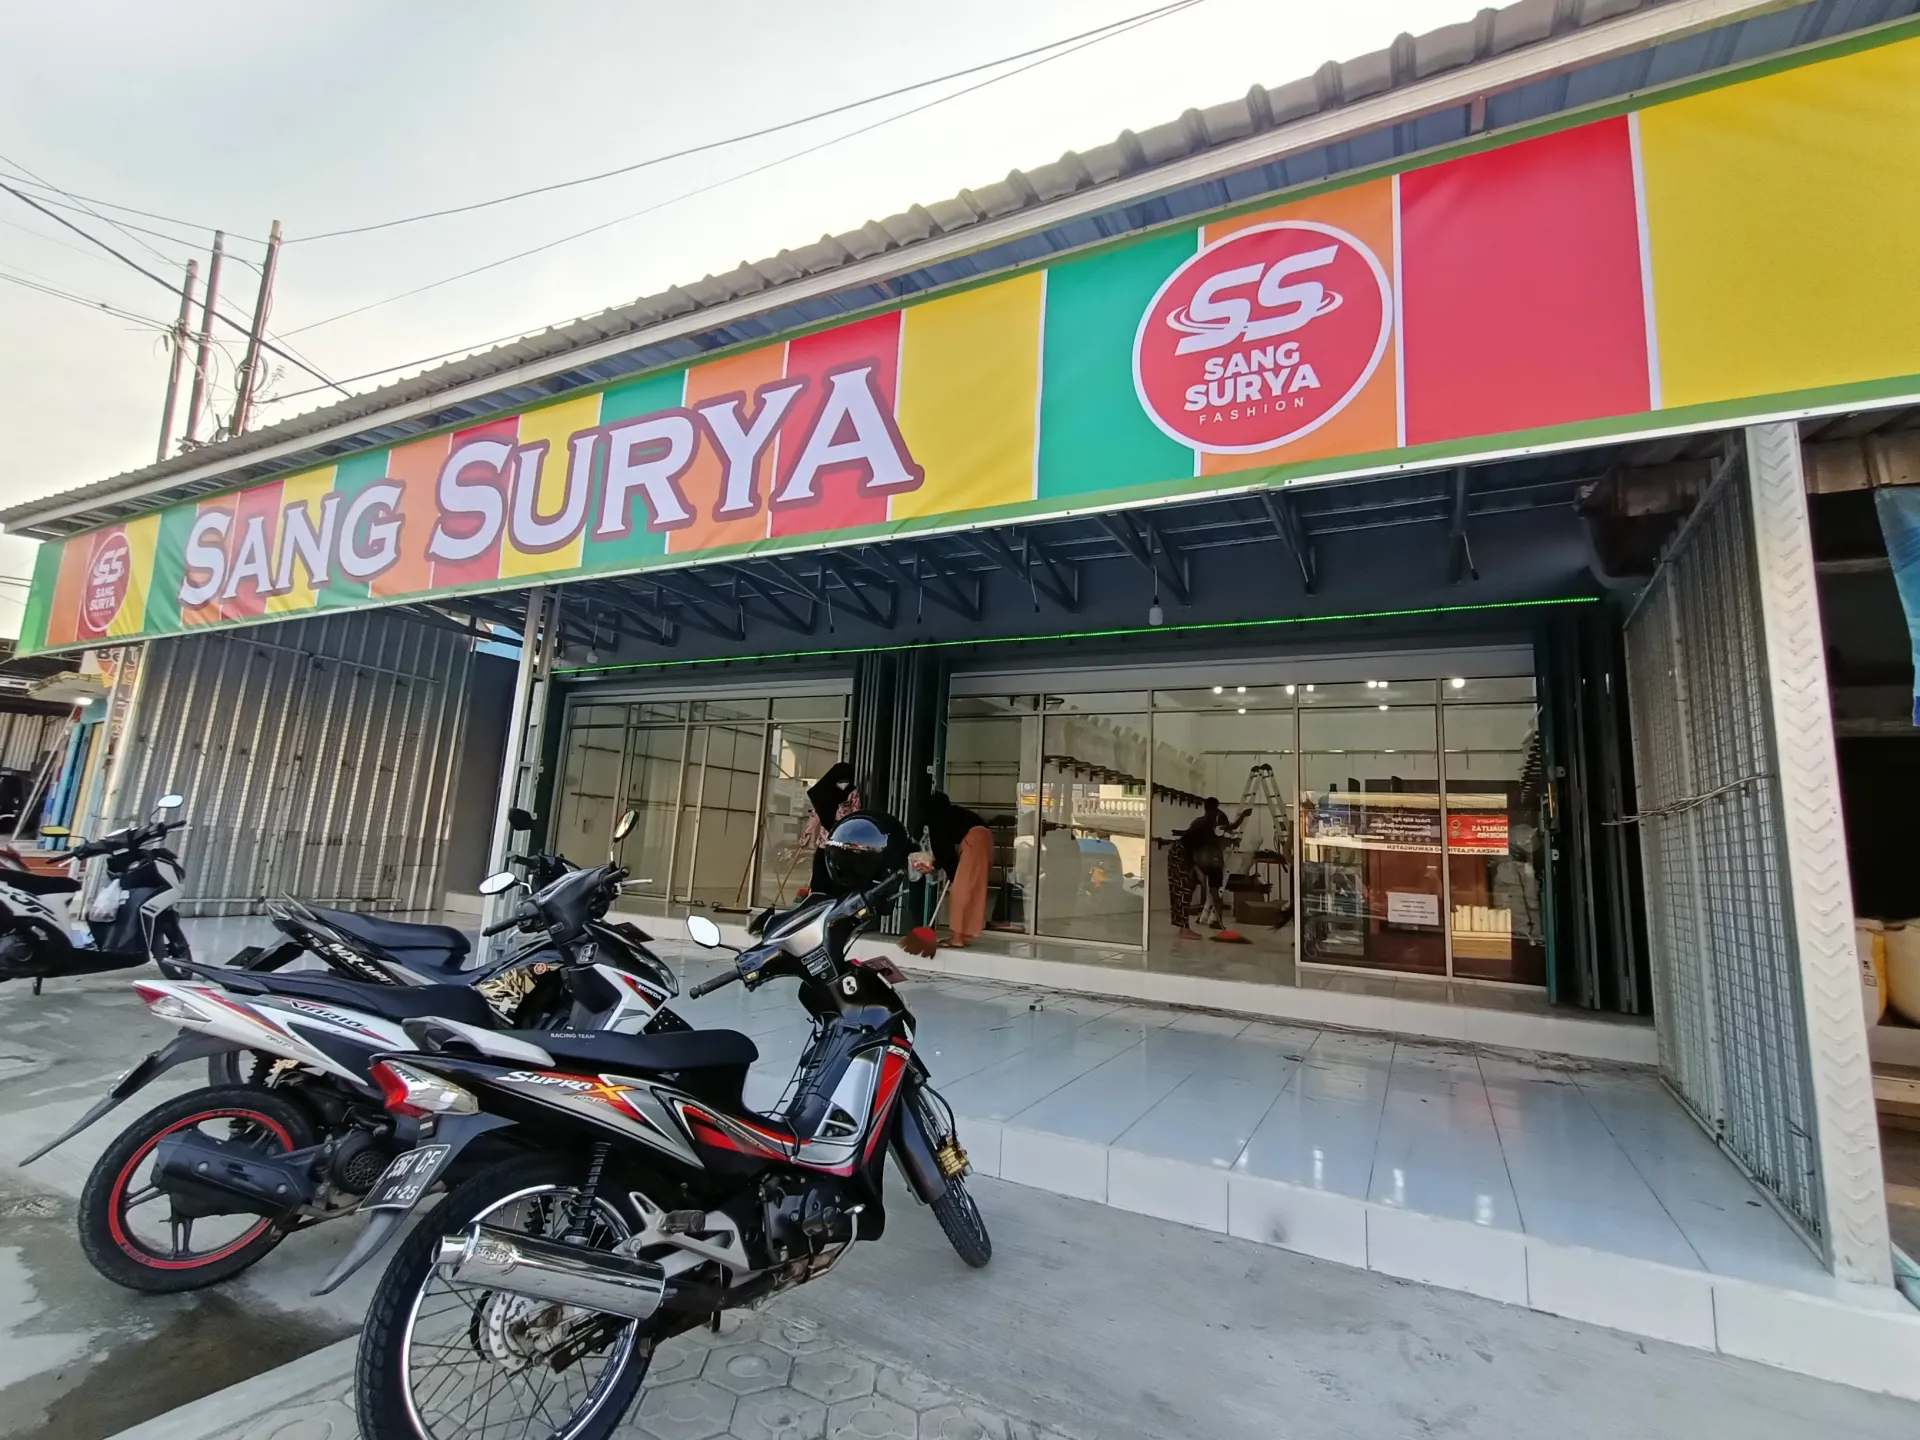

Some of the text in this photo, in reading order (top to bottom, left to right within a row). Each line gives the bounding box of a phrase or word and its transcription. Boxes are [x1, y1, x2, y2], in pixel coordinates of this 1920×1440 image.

[1202, 341, 1301, 382] SANG
[1182, 363, 1321, 412] SURYA
[1198, 396, 1305, 426] FASHION
[178, 362, 919, 607] SANG SURYA
[636, 984, 662, 1001] HONDA
[414, 1150, 441, 1174] CF
